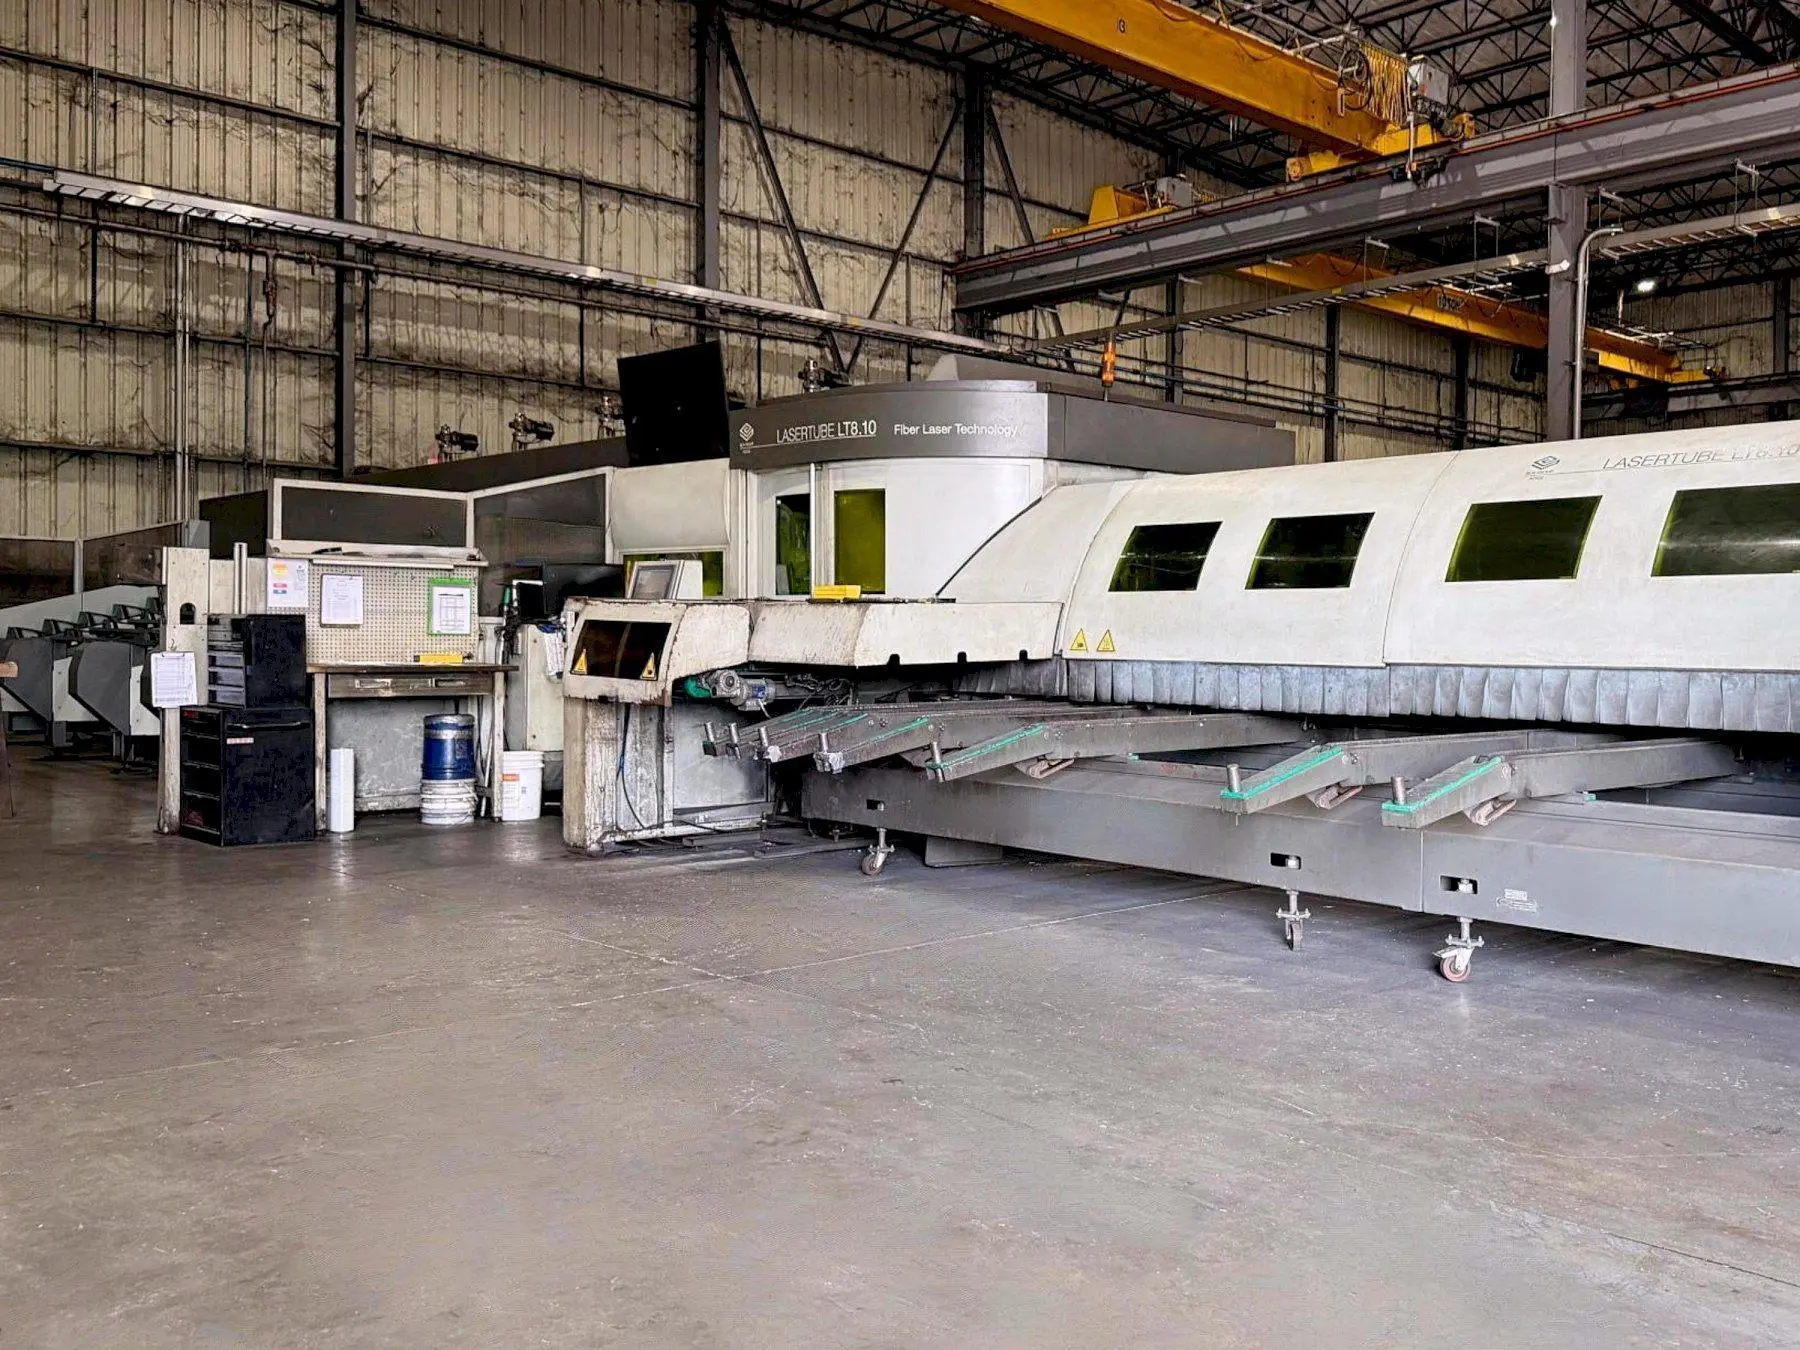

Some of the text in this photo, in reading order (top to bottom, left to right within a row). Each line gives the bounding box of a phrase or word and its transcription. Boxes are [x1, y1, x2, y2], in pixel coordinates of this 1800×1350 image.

[777, 420, 877, 443] LASERTUBE LT8.10
[893, 423, 1018, 438] Fiber Laser Technology
[1602, 450, 1726, 470] LASERTUBE
